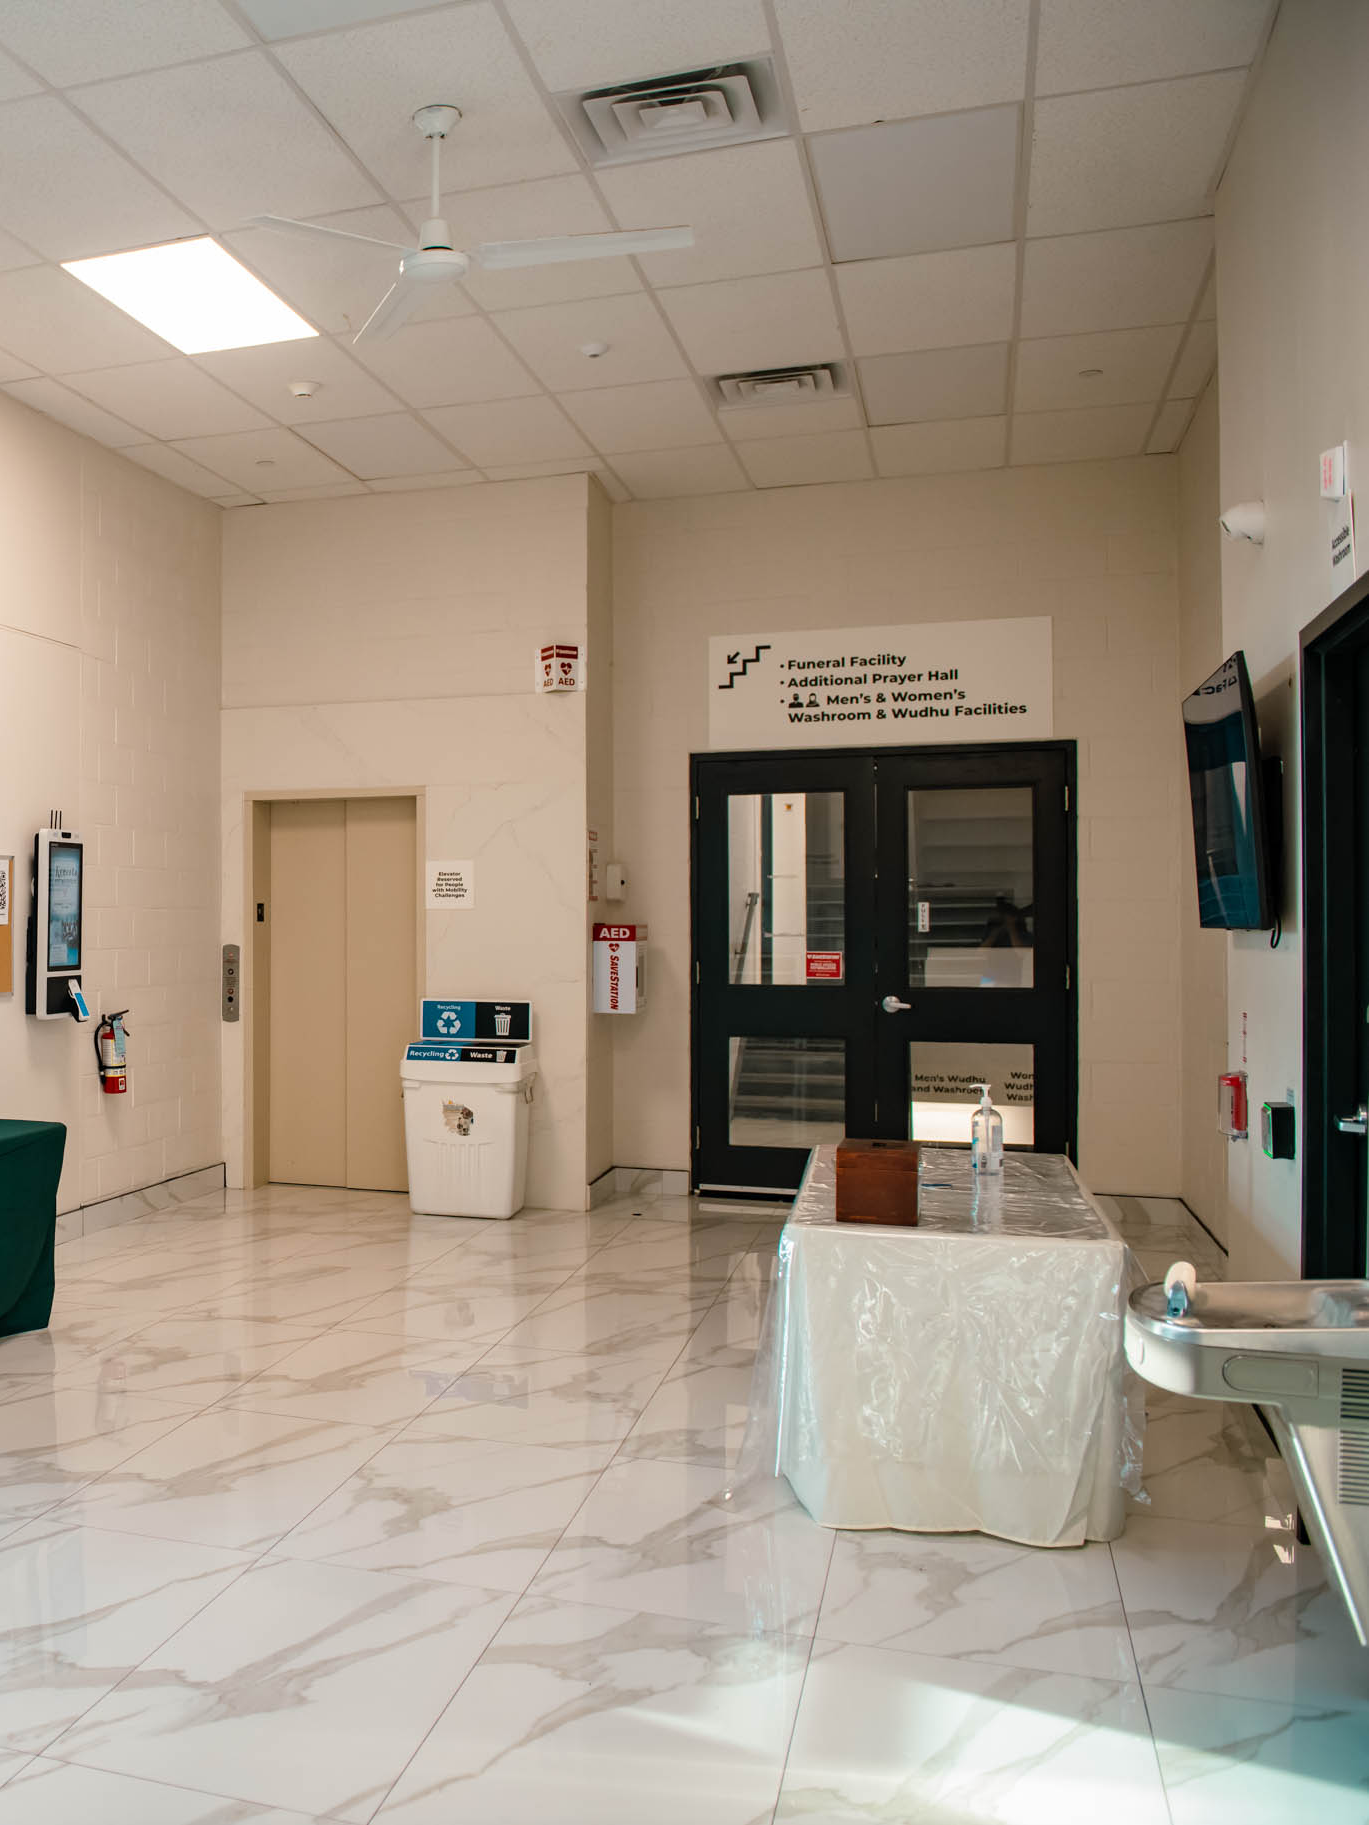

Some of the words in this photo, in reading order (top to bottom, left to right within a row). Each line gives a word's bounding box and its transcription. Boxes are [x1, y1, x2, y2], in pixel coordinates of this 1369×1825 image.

[788, 657, 845, 670] Funeral
[850, 654, 907, 667] Facility
[558, 677, 576, 686] AED
[788, 674, 868, 688] Additional
[872, 673, 923, 685] Prayer
[928, 669, 959, 681] Hall
[826, 693, 871, 705] Men's
[876, 693, 887, 703] &
[891, 689, 966, 702] Women's
[788, 711, 872, 723] Washroom
[876, 709, 887, 719] &
[892, 707, 950, 719] Wudhu
[954, 703, 1028, 716] Facilities
[599, 927, 630, 939] AED
[409, 1050, 444, 1058] Recycling
[470, 1051, 493, 1059] Waste
[914, 1073, 944, 1082] Men's
[947, 1074, 986, 1084] Wudhu
[911, 1085, 930, 1093] and
